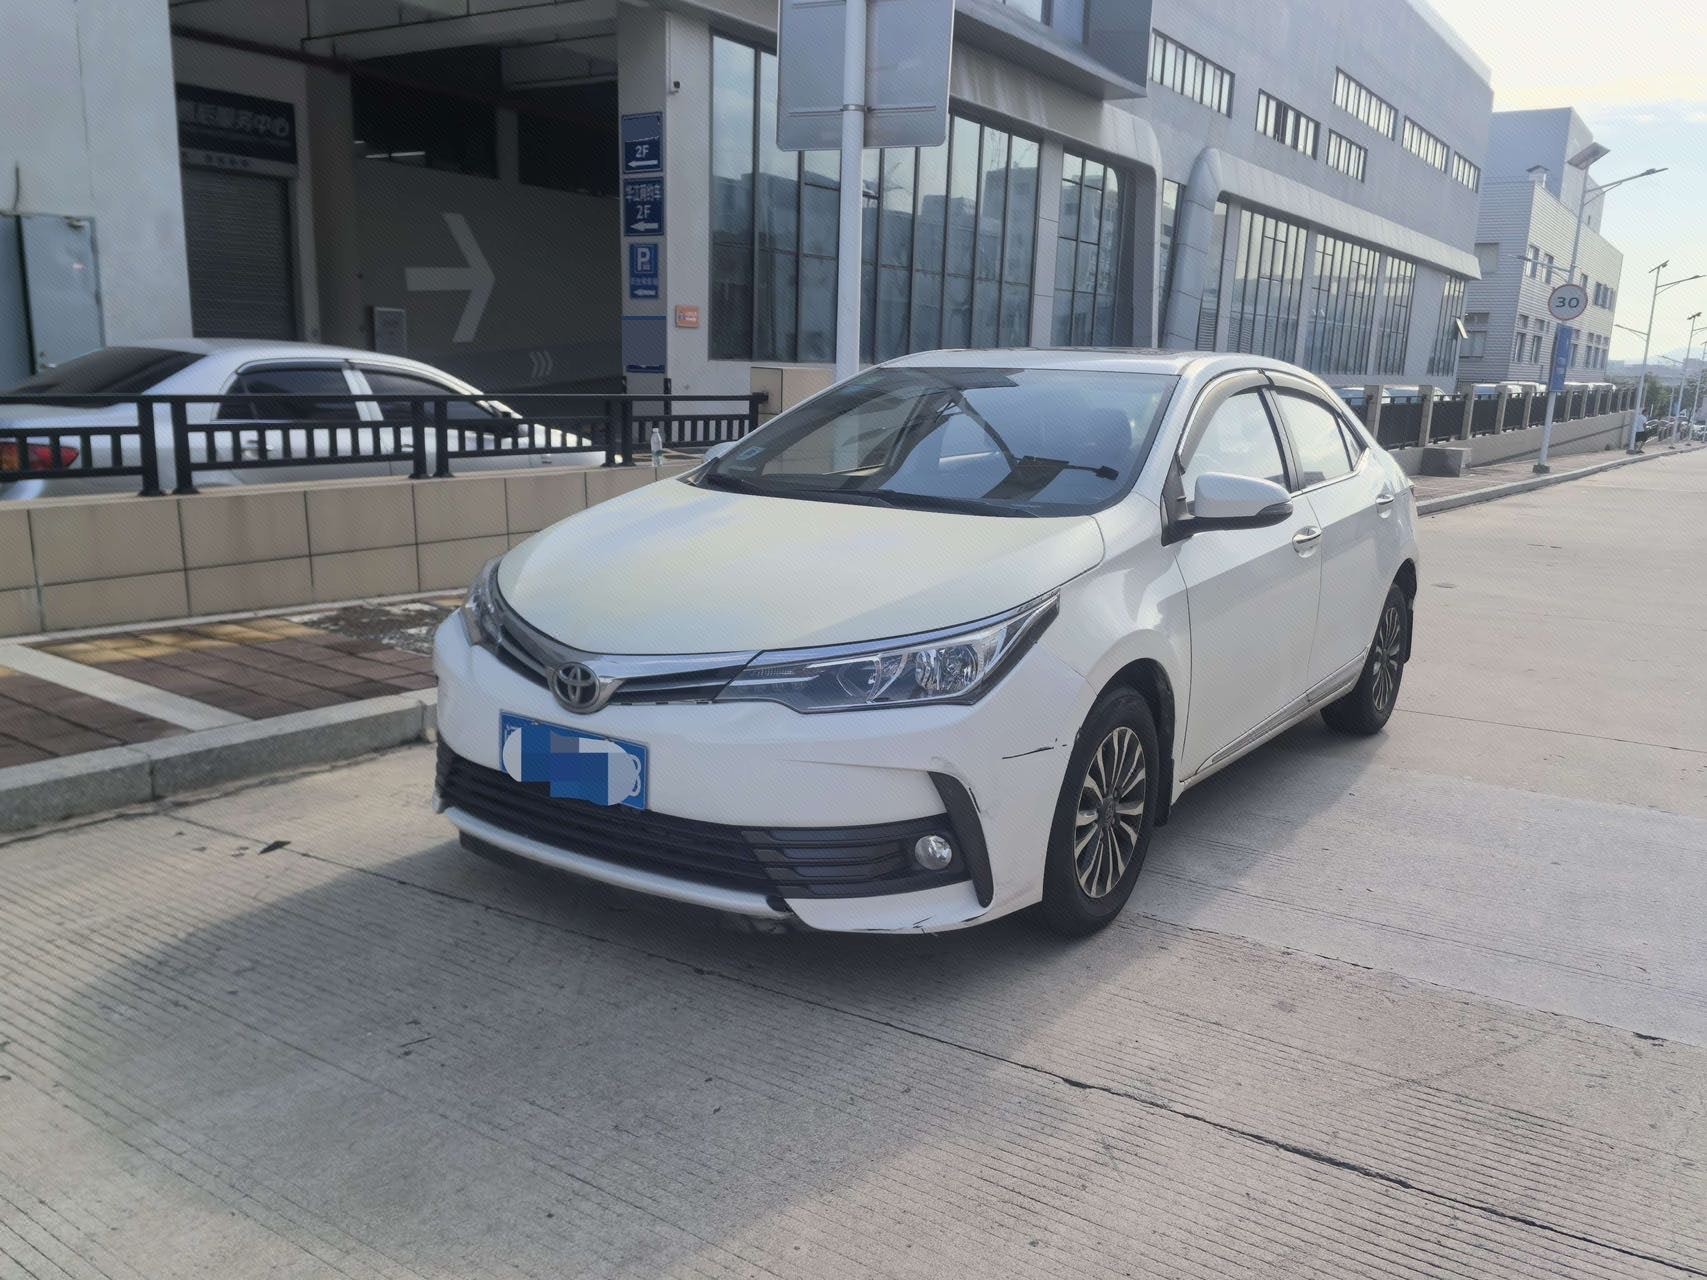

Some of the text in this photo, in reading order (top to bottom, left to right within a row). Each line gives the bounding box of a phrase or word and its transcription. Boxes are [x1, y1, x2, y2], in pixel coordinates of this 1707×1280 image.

[635, 144, 649, 158] 2F
[636, 204, 651, 219] 2F
[637, 247, 651, 271] P
[1555, 296, 1580, 309] 30
